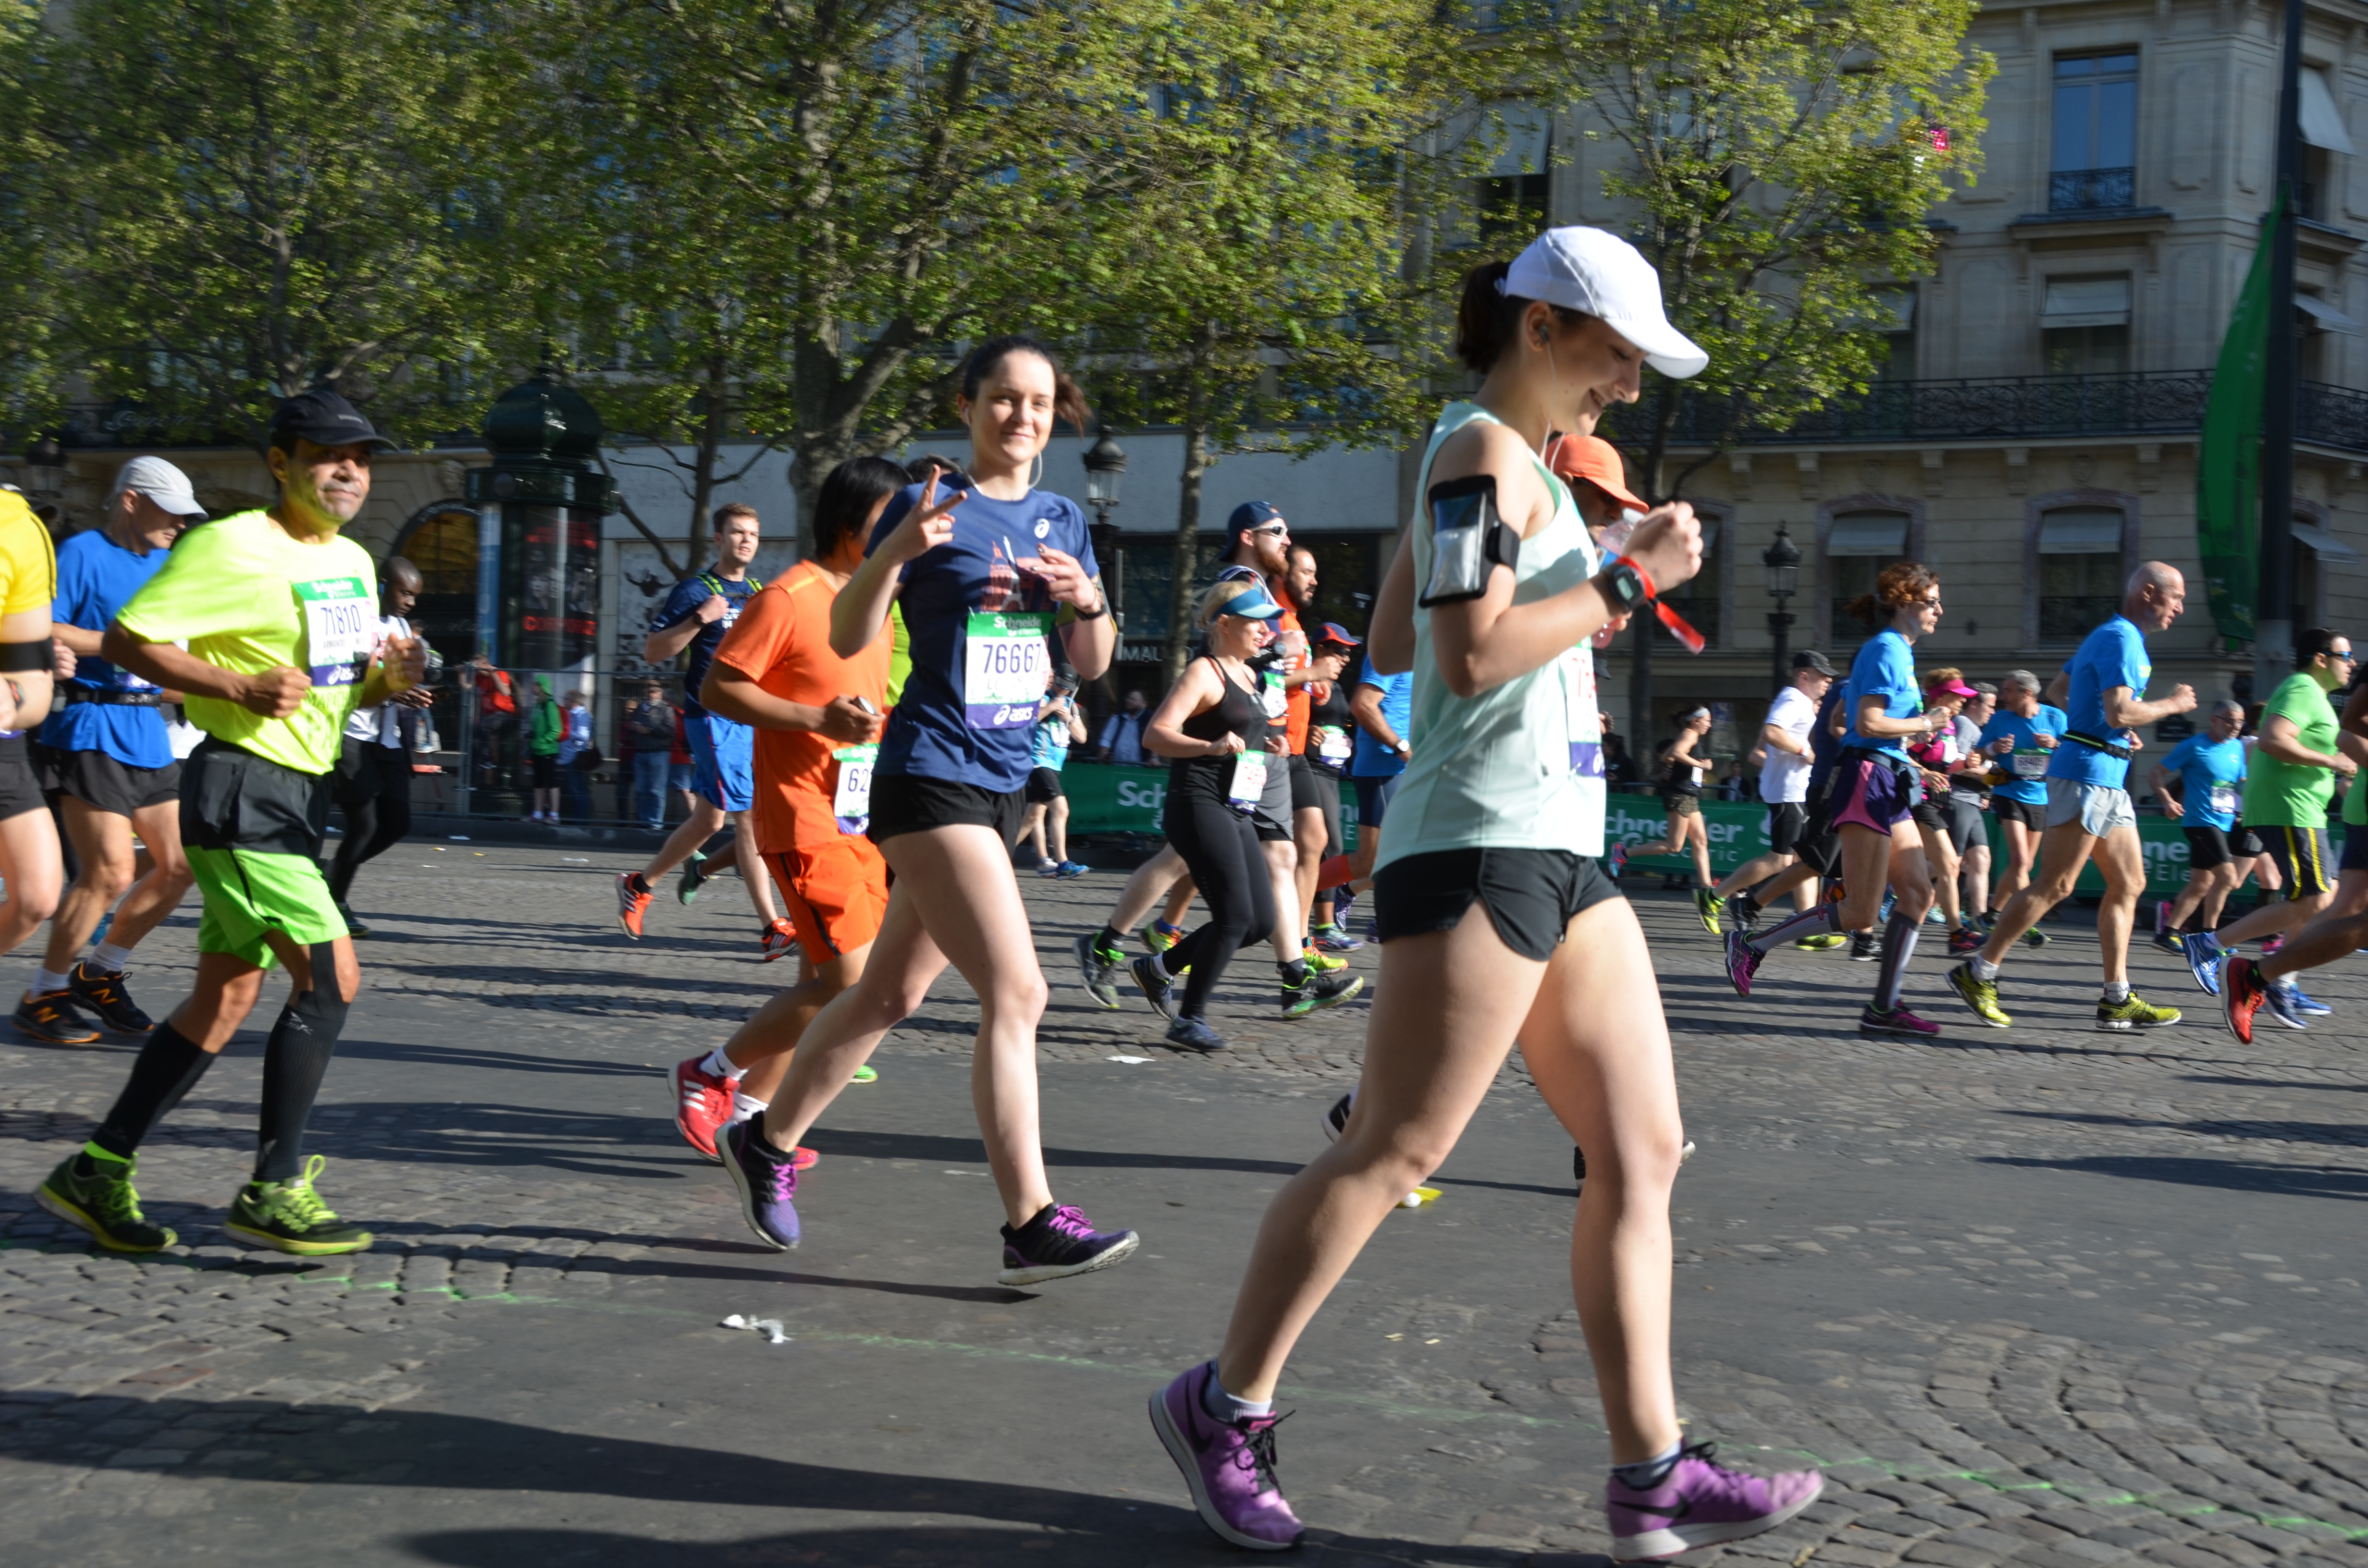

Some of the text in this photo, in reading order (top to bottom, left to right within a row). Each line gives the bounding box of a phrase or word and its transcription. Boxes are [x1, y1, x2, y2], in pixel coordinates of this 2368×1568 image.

[321, 604, 361, 636] 71810
[983, 643, 1041, 674] 76667
[1009, 707, 1033, 722] asics
[848, 768, 869, 793] 62
